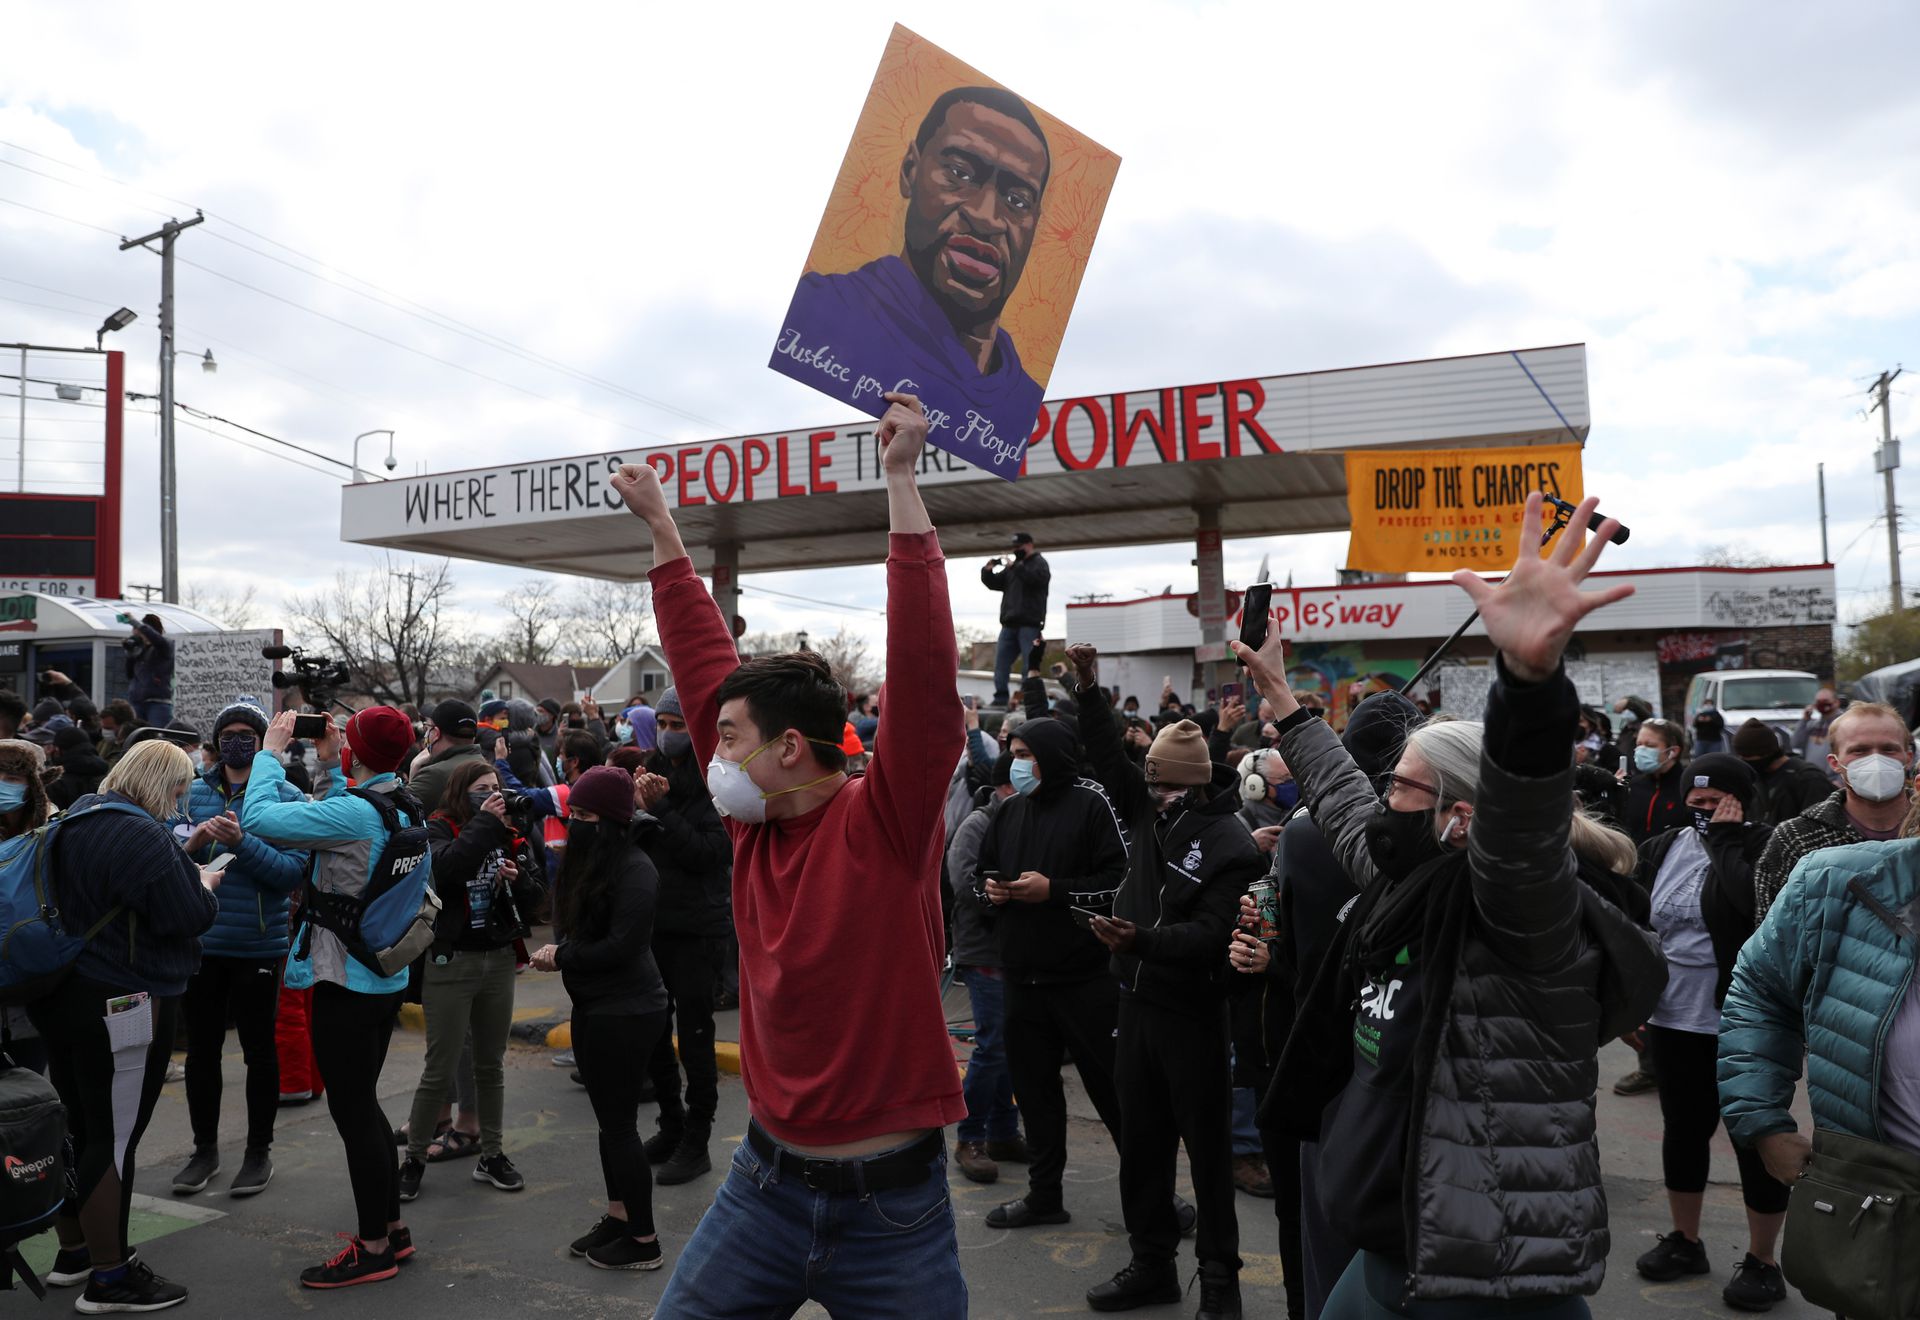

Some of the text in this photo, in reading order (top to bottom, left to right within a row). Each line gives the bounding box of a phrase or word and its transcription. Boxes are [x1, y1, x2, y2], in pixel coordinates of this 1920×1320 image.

[777, 328, 850, 382] Justice
[852, 374, 885, 399] for
[955, 409, 1027, 466] Floyd
[406, 474, 497, 525] WHERE
[511, 455, 624, 513] THERE'S
[1375, 468, 1425, 509] DROP
[1433, 466, 1463, 509] THE
[1378, 515, 1433, 528] PROTEST
[1442, 514, 1455, 526] IS
[1461, 513, 1484, 526] NOT
[1495, 513, 1502, 524] A
[40, 581, 68, 595] FOR
[10, 1155, 54, 1178] Lowepro
